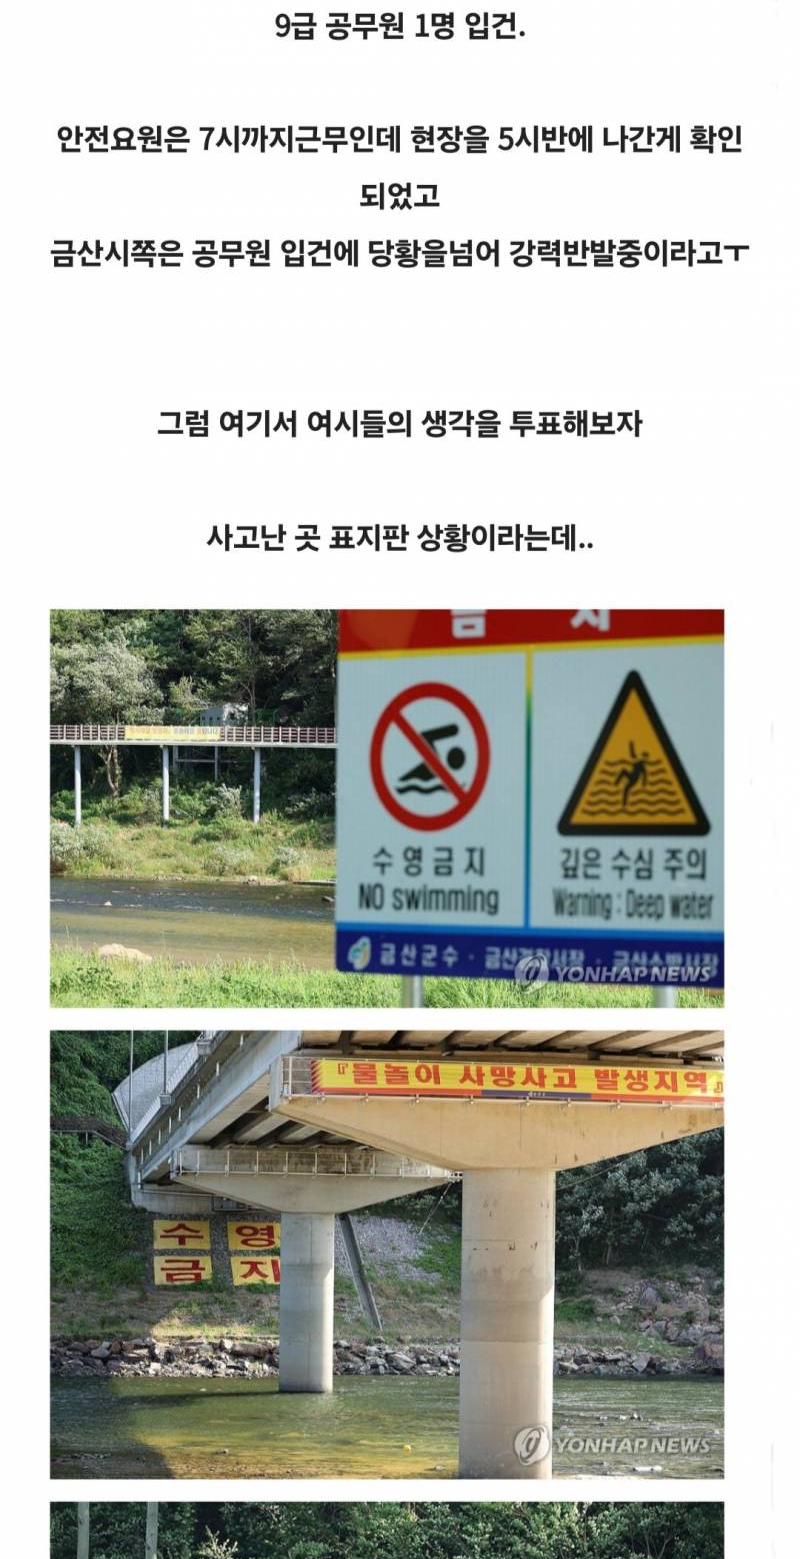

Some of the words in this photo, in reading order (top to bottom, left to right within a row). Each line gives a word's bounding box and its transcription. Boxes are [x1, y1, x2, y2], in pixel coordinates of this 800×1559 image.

[205, 523, 288, 553] 사고난
[293, 523, 322, 553] 곳
[328, 523, 410, 553] 표지판
[416, 522, 594, 554] 상황이라는데..
[373, 846, 485, 877] 수영금지
[560, 847, 602, 880] 깊은
[612, 847, 654, 880] 수심
[663, 847, 707, 880] 주의
[358, 883, 385, 910] NO
[392, 884, 499, 916] swimming
[552, 887, 612, 920] Warning
[626, 888, 665, 920] Deep
[669, 892, 714, 920] water
[459, 1063, 577, 1089] 사망사고
